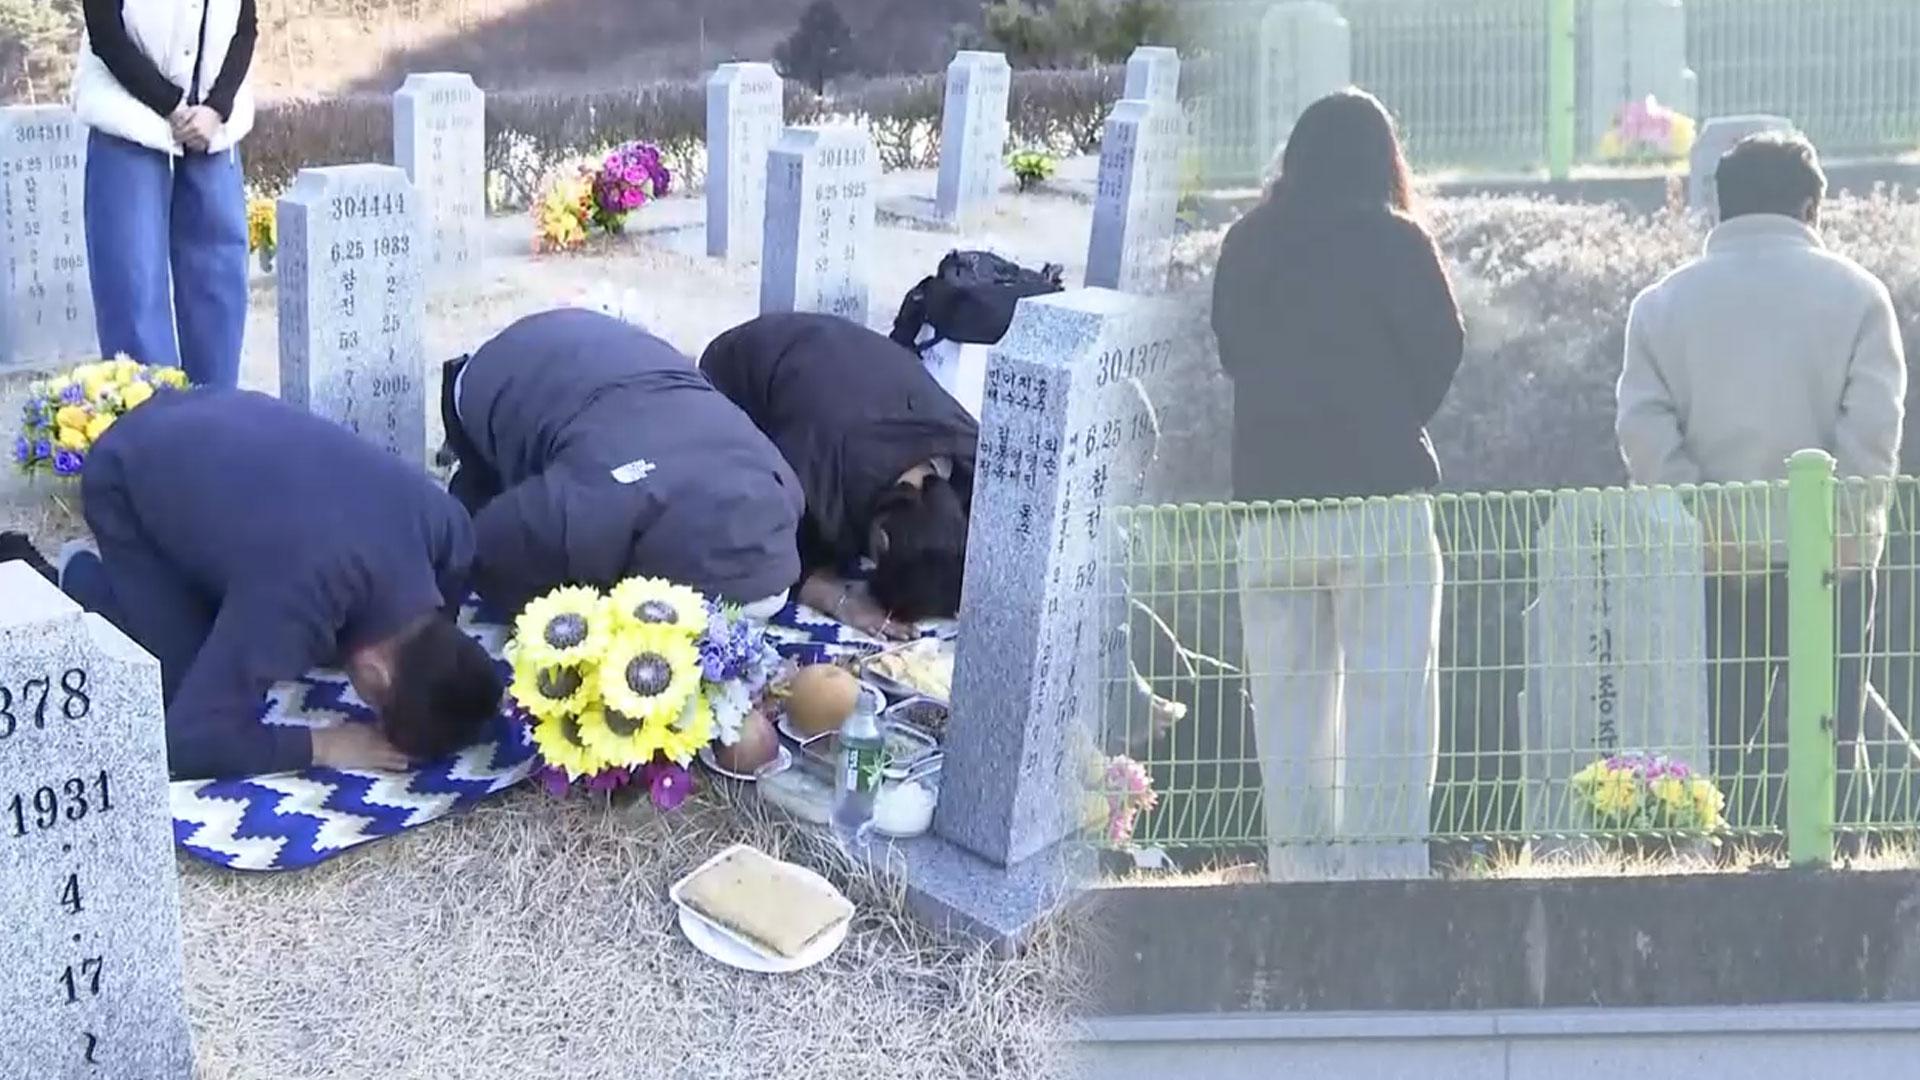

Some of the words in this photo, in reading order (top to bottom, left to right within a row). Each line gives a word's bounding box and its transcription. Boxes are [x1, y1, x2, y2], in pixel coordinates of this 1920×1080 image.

[332, 193, 405, 221] 304444
[331, 240, 365, 266] 6.25
[1097, 338, 1172, 387] 304377
[1086, 419, 1122, 458] 6.25
[7, 770, 115, 838] 1931
[60, 872, 85, 916] 4
[59, 955, 105, 1005] 17
